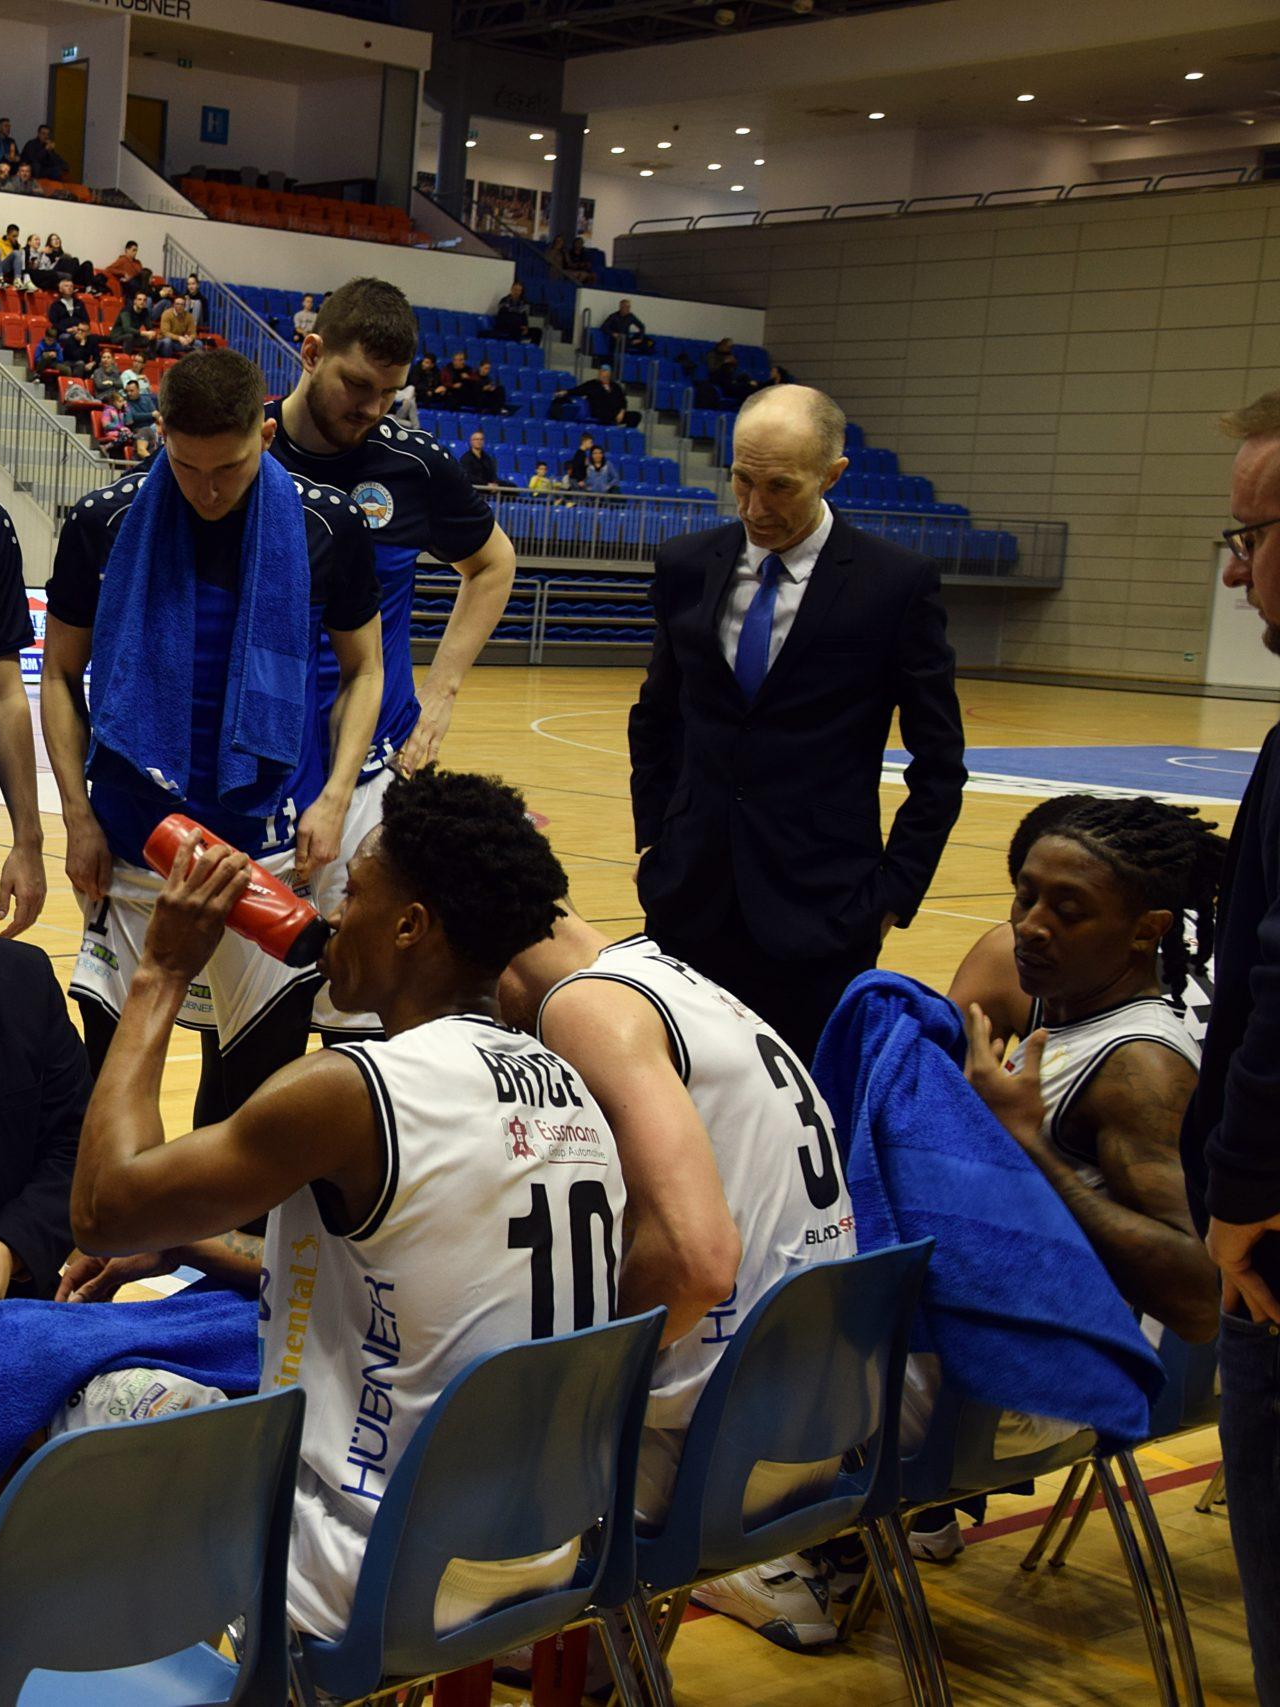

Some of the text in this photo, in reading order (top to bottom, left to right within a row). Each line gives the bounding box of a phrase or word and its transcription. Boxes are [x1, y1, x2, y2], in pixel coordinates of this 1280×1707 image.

[104, 0, 190, 20] BNER
[472, 1042, 584, 1108] BRYCE
[534, 1119, 600, 1145] Eissmann
[755, 1033, 850, 1211] 3
[507, 1180, 617, 1341] 10
[273, 1263, 318, 1388] inental
[340, 1274, 401, 1503] HÜBNER
